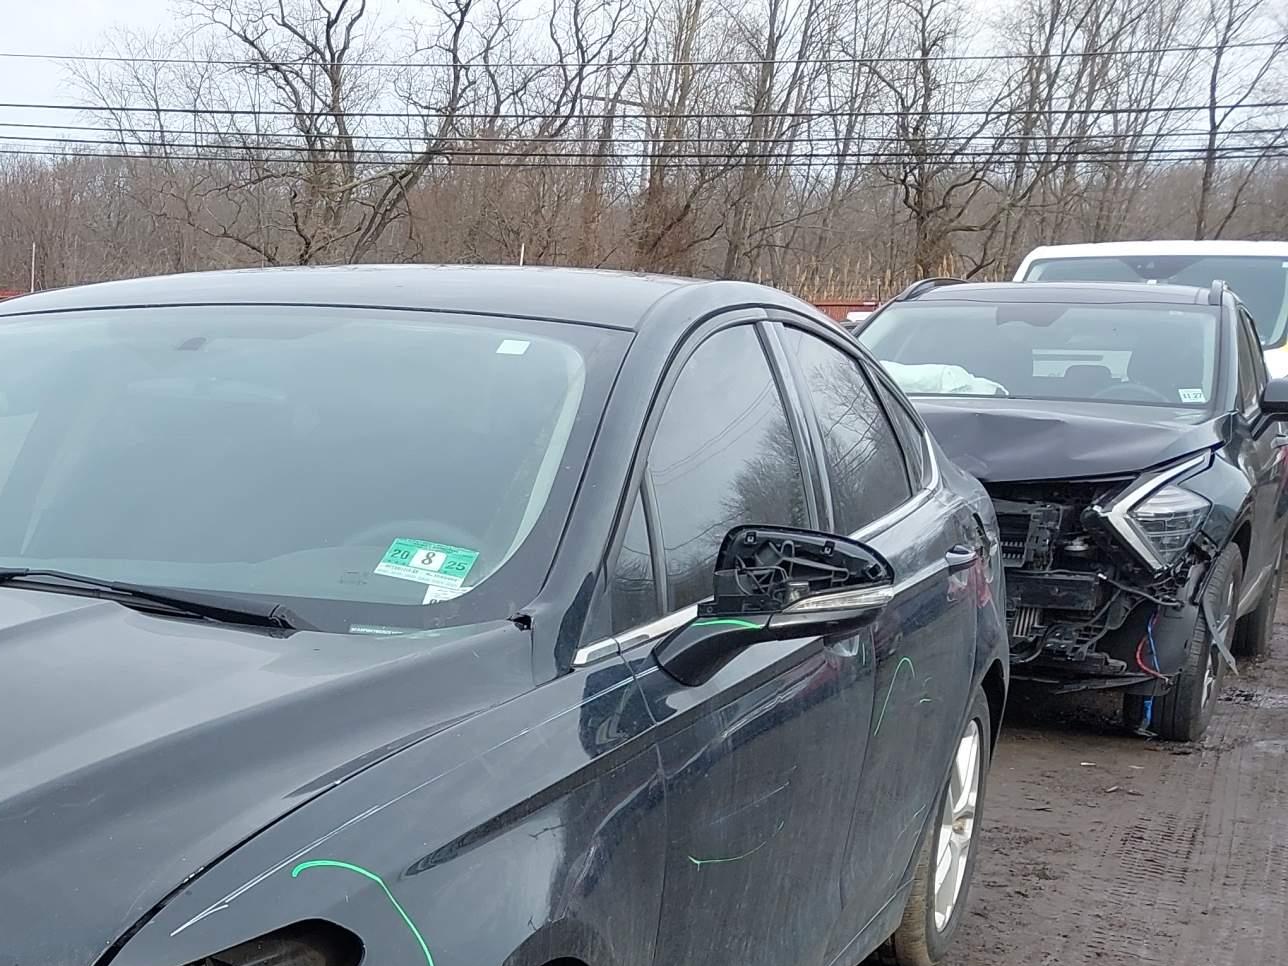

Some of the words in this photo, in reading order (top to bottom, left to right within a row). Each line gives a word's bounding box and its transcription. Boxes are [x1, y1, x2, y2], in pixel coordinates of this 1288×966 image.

[390, 548, 411, 560] 20
[421, 551, 436, 566] 8
[444, 560, 468, 571] 25
